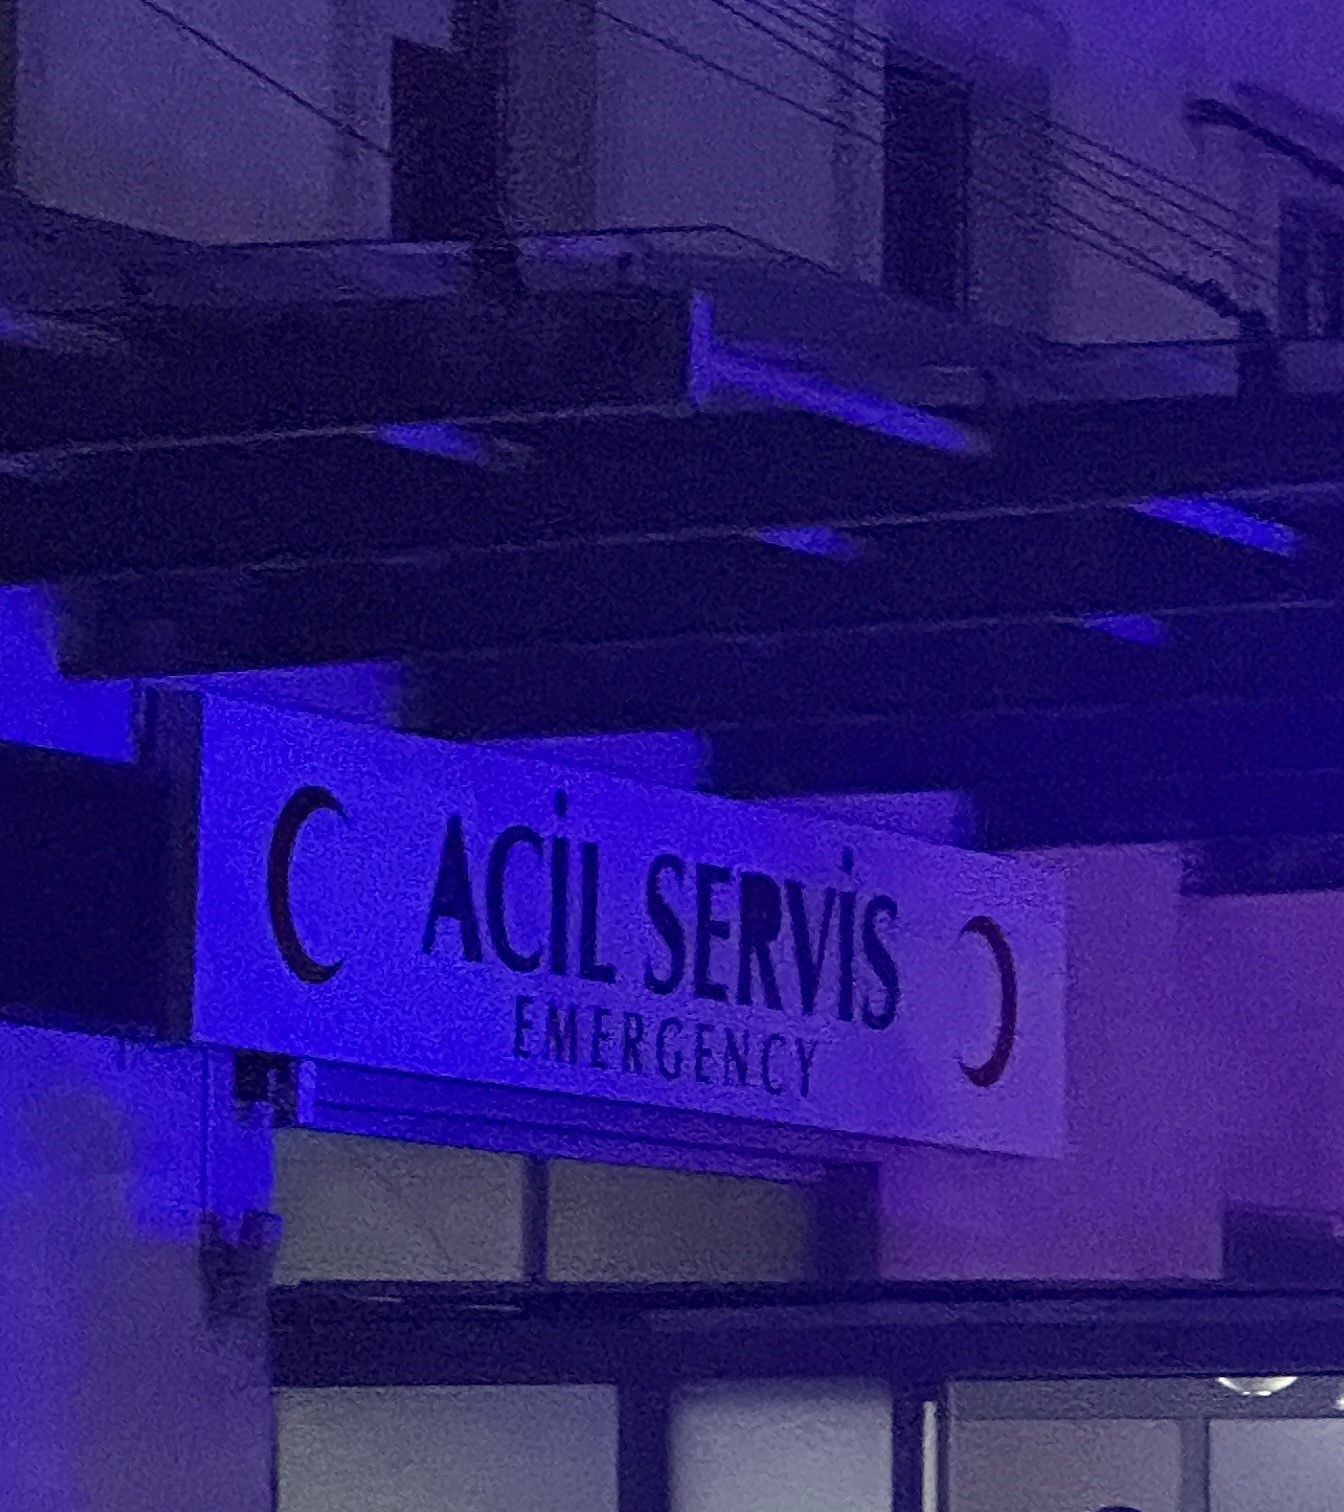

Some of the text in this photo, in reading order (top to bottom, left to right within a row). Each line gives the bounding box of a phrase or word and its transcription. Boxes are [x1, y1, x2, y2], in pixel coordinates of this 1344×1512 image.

[421, 790, 903, 1031] ACİL SERVİS
[513, 995, 820, 1099] EMERGENCY
